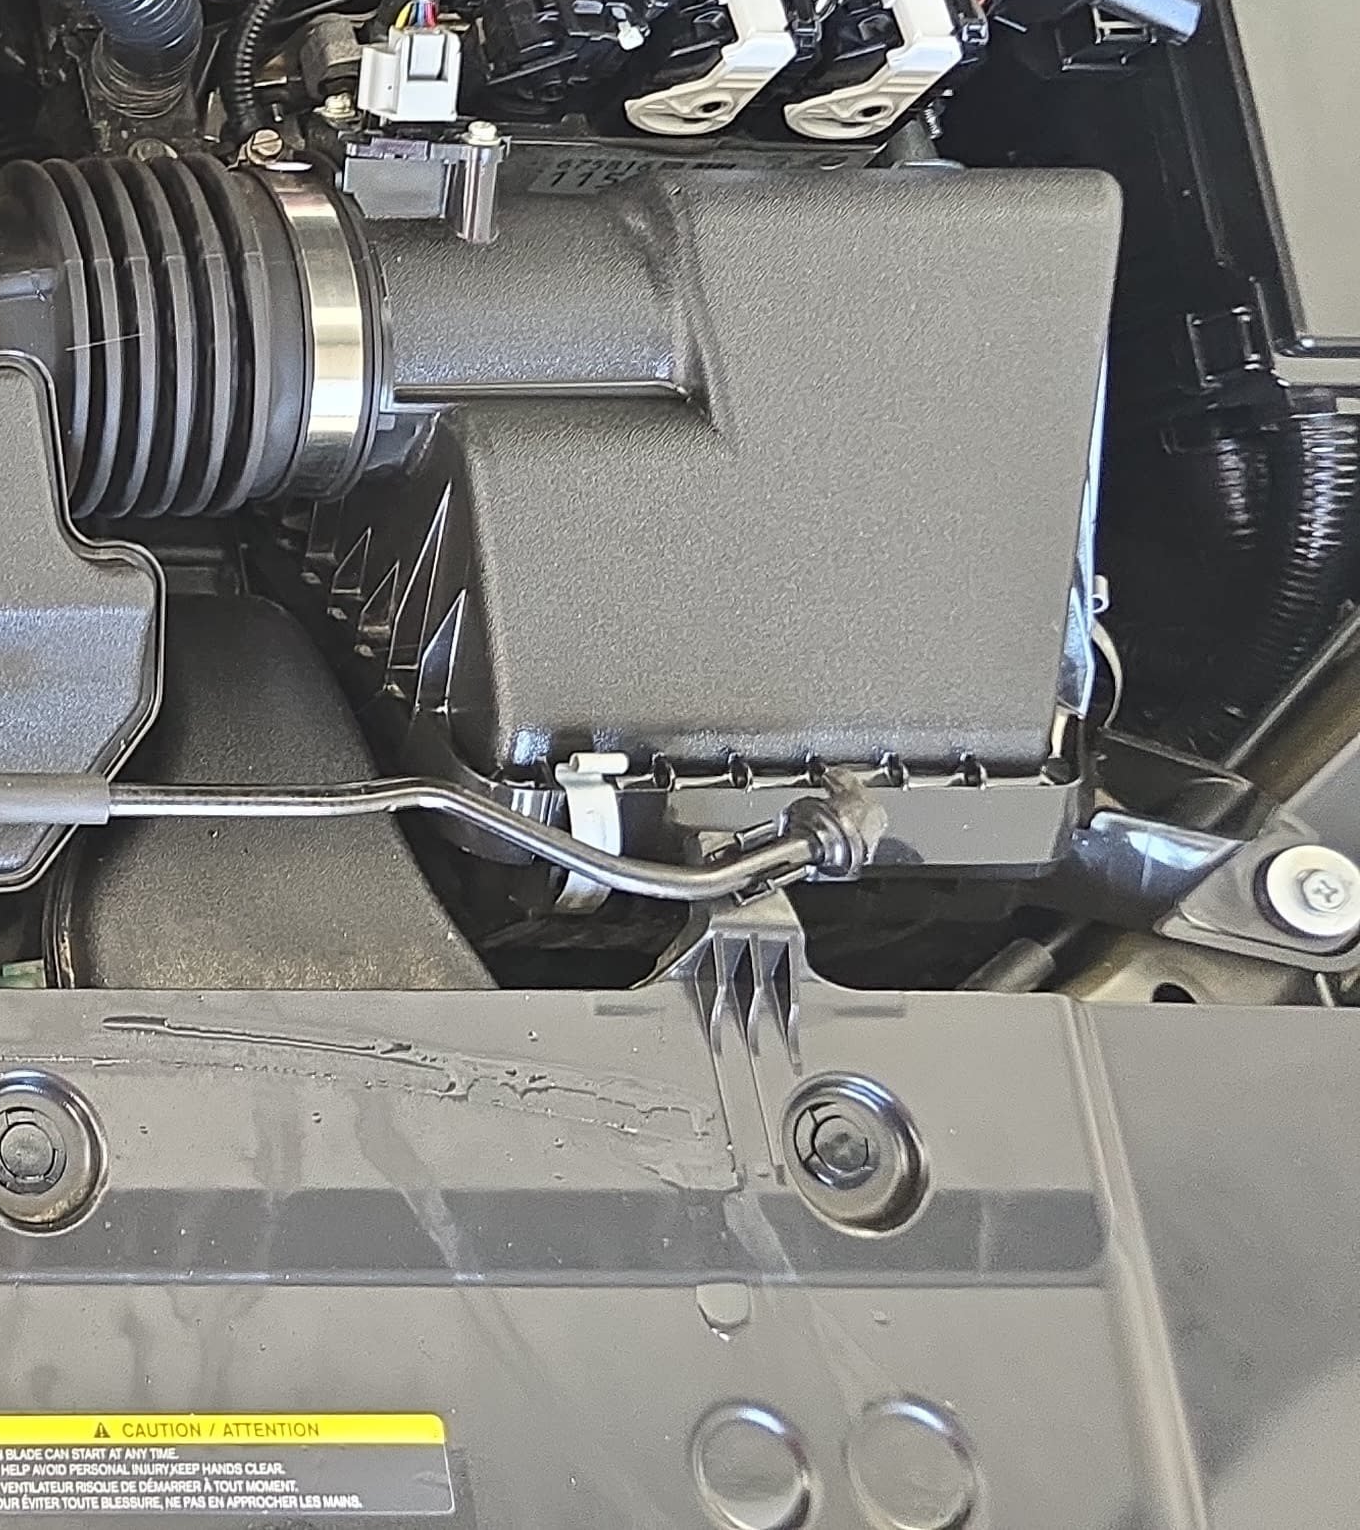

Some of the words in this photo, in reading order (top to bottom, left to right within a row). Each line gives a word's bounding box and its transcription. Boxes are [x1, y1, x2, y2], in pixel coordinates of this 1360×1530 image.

[122, 1423, 201, 1438] CAUTION
[223, 1423, 320, 1437] ATTENTION
[6, 1449, 43, 1461] BLADE
[44, 1449, 69, 1460] CAN
[71, 1448, 106, 1460] START
[108, 1448, 123, 1460] AT
[124, 1448, 148, 1460] ANY
[1, 1464, 30, 1476] HELP
[32, 1464, 67, 1476] AVOID
[69, 1464, 130, 1476] PERSONAL
[202, 1463, 242, 1475] HANDS
[244, 1463, 286, 1474] CLEAR.
[1, 1481, 74, 1493] VENTILATEUR
[76, 1481, 119, 1493] RISQUE
[120, 1481, 137, 1493] DE
[139, 1477, 201, 1493] DÉMARRER
[204, 1477, 212, 1492] À
[214, 1480, 244, 1493] TOUT
[246, 1480, 299, 1492] MOMENT.
[22, 1494, 60, 1510] ÉVITER
[62, 1497, 99, 1510] TOUTE
[101, 1497, 164, 1510] BLESSURE,
[165, 1496, 182, 1508] NE
[184, 1496, 206, 1509] PAS
[208, 1496, 225, 1508] EN
[227, 1496, 298, 1508] APPROCHER
[299, 1496, 324, 1508] LES
[324, 1495, 363, 1508] MAINS.
